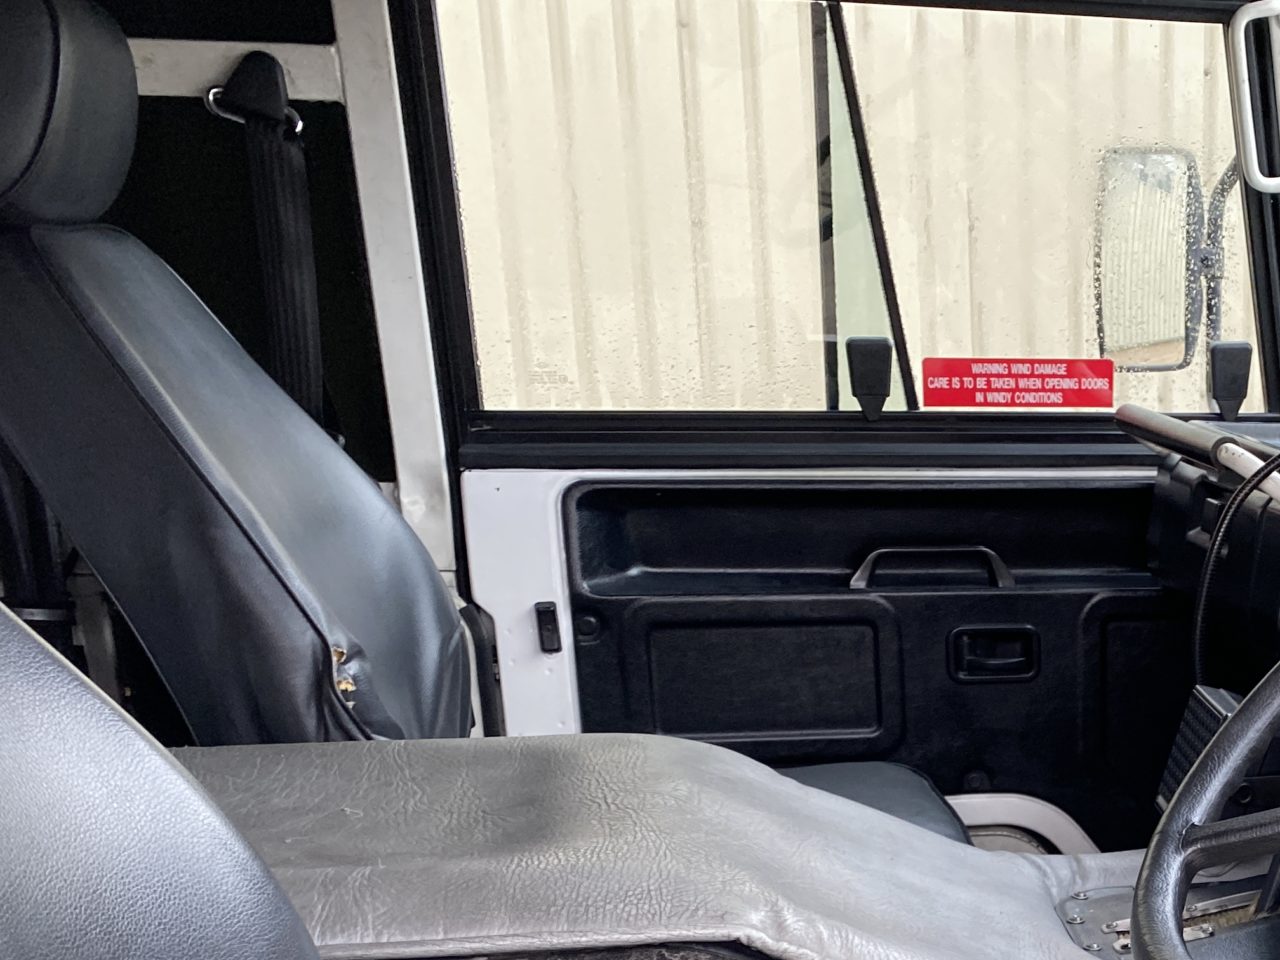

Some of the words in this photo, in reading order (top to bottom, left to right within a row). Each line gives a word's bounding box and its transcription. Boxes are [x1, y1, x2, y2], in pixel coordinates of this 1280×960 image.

[971, 363, 1008, 375] WARNING
[1010, 363, 1031, 375] WIND
[1034, 363, 1067, 375] DAMAGE
[927, 377, 949, 389] CARE
[951, 377, 960, 389] IS
[962, 377, 973, 389] TO
[976, 377, 987, 389] BE
[990, 377, 1016, 389] TAKEN
[1018, 377, 1041, 389] WHEN
[1044, 377, 1078, 389] OPENING
[1081, 378, 1109, 390] DOORS
[975, 392, 984, 403] IN
[986, 392, 1012, 403] WINDY
[1014, 392, 1063, 403] CONDITIONS
